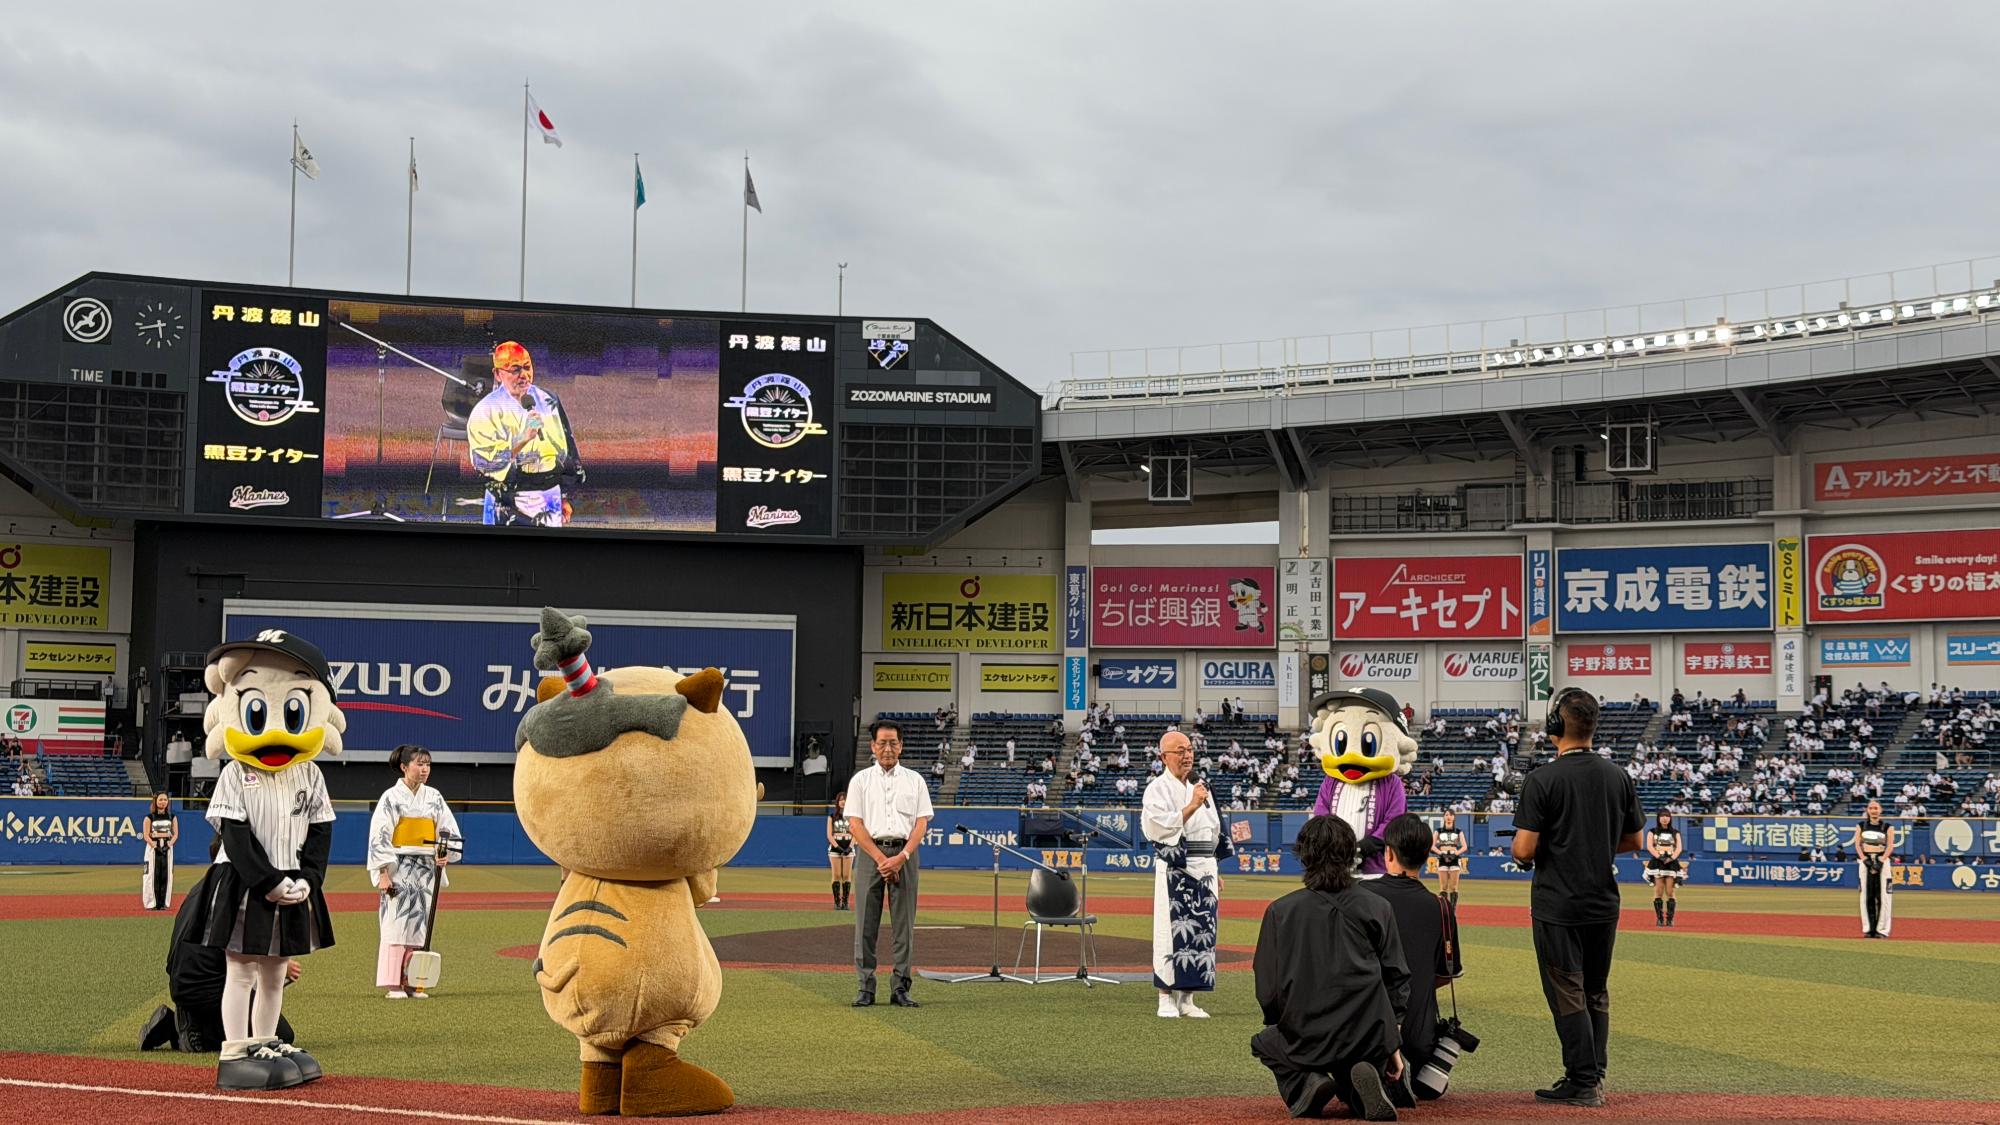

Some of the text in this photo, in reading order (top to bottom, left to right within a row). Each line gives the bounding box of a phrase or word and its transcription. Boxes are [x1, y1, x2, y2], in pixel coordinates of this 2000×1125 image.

[212, 304, 320, 327] 丹波篠山
[728, 334, 827, 352] 丹波篠山
[71, 369, 103, 383] TIME
[850, 390, 991, 404] ZOZOMARINE STADIUM
[203, 444, 319, 464] 黒豆ナイター
[723, 467, 827, 483] 黒豆ナイター
[229, 485, 290, 509] Marines
[747, 505, 801, 528] Marines
[1915, 554, 1997, 566] Smile every day!
[1410, 574, 1466, 582] ARCHICEPT
[0, 572, 100, 609] 本建設
[1100, 583, 1220, 593] Go! Go! Marines!
[1563, 564, 1768, 613] 京成電鉄
[1783, 552, 1794, 625] SCミート
[1068, 573, 1080, 640] 東葛グループ
[1286, 583, 1298, 617] 明正
[1310, 577, 1322, 631] 吉田工業
[890, 601, 1049, 632] 新日本建設
[1098, 597, 1221, 628] ちば興銀
[1339, 587, 1519, 631] アーキセプト
[15, 613, 98, 626] DEVELOPER
[892, 638, 1048, 649] INTELLIGENT DEVELOPER
[29, 652, 113, 663] エクセレントシティ
[1363, 652, 1418, 664] MARUEI
[1468, 651, 1524, 664] MARUEI
[1569, 656, 1650, 671] 宇野澤鉄工
[1686, 655, 1771, 670] 宇野澤鉄工
[876, 671, 949, 683] EXCELLENT CITY
[984, 674, 1056, 683] エクセレントシティ
[1127, 665, 1175, 684] オグラ
[1204, 662, 1275, 679] OGURA
[1368, 665, 1412, 679] Group
[1472, 665, 1518, 679] Group
[1531, 653, 1548, 700] ホクト
[28, 816, 136, 837] KAKUTA
[968, 830, 1018, 846] Trunk
[1741, 823, 1912, 848] 新宿健診プザ
[1740, 864, 1844, 881] 立川健診プラザ
